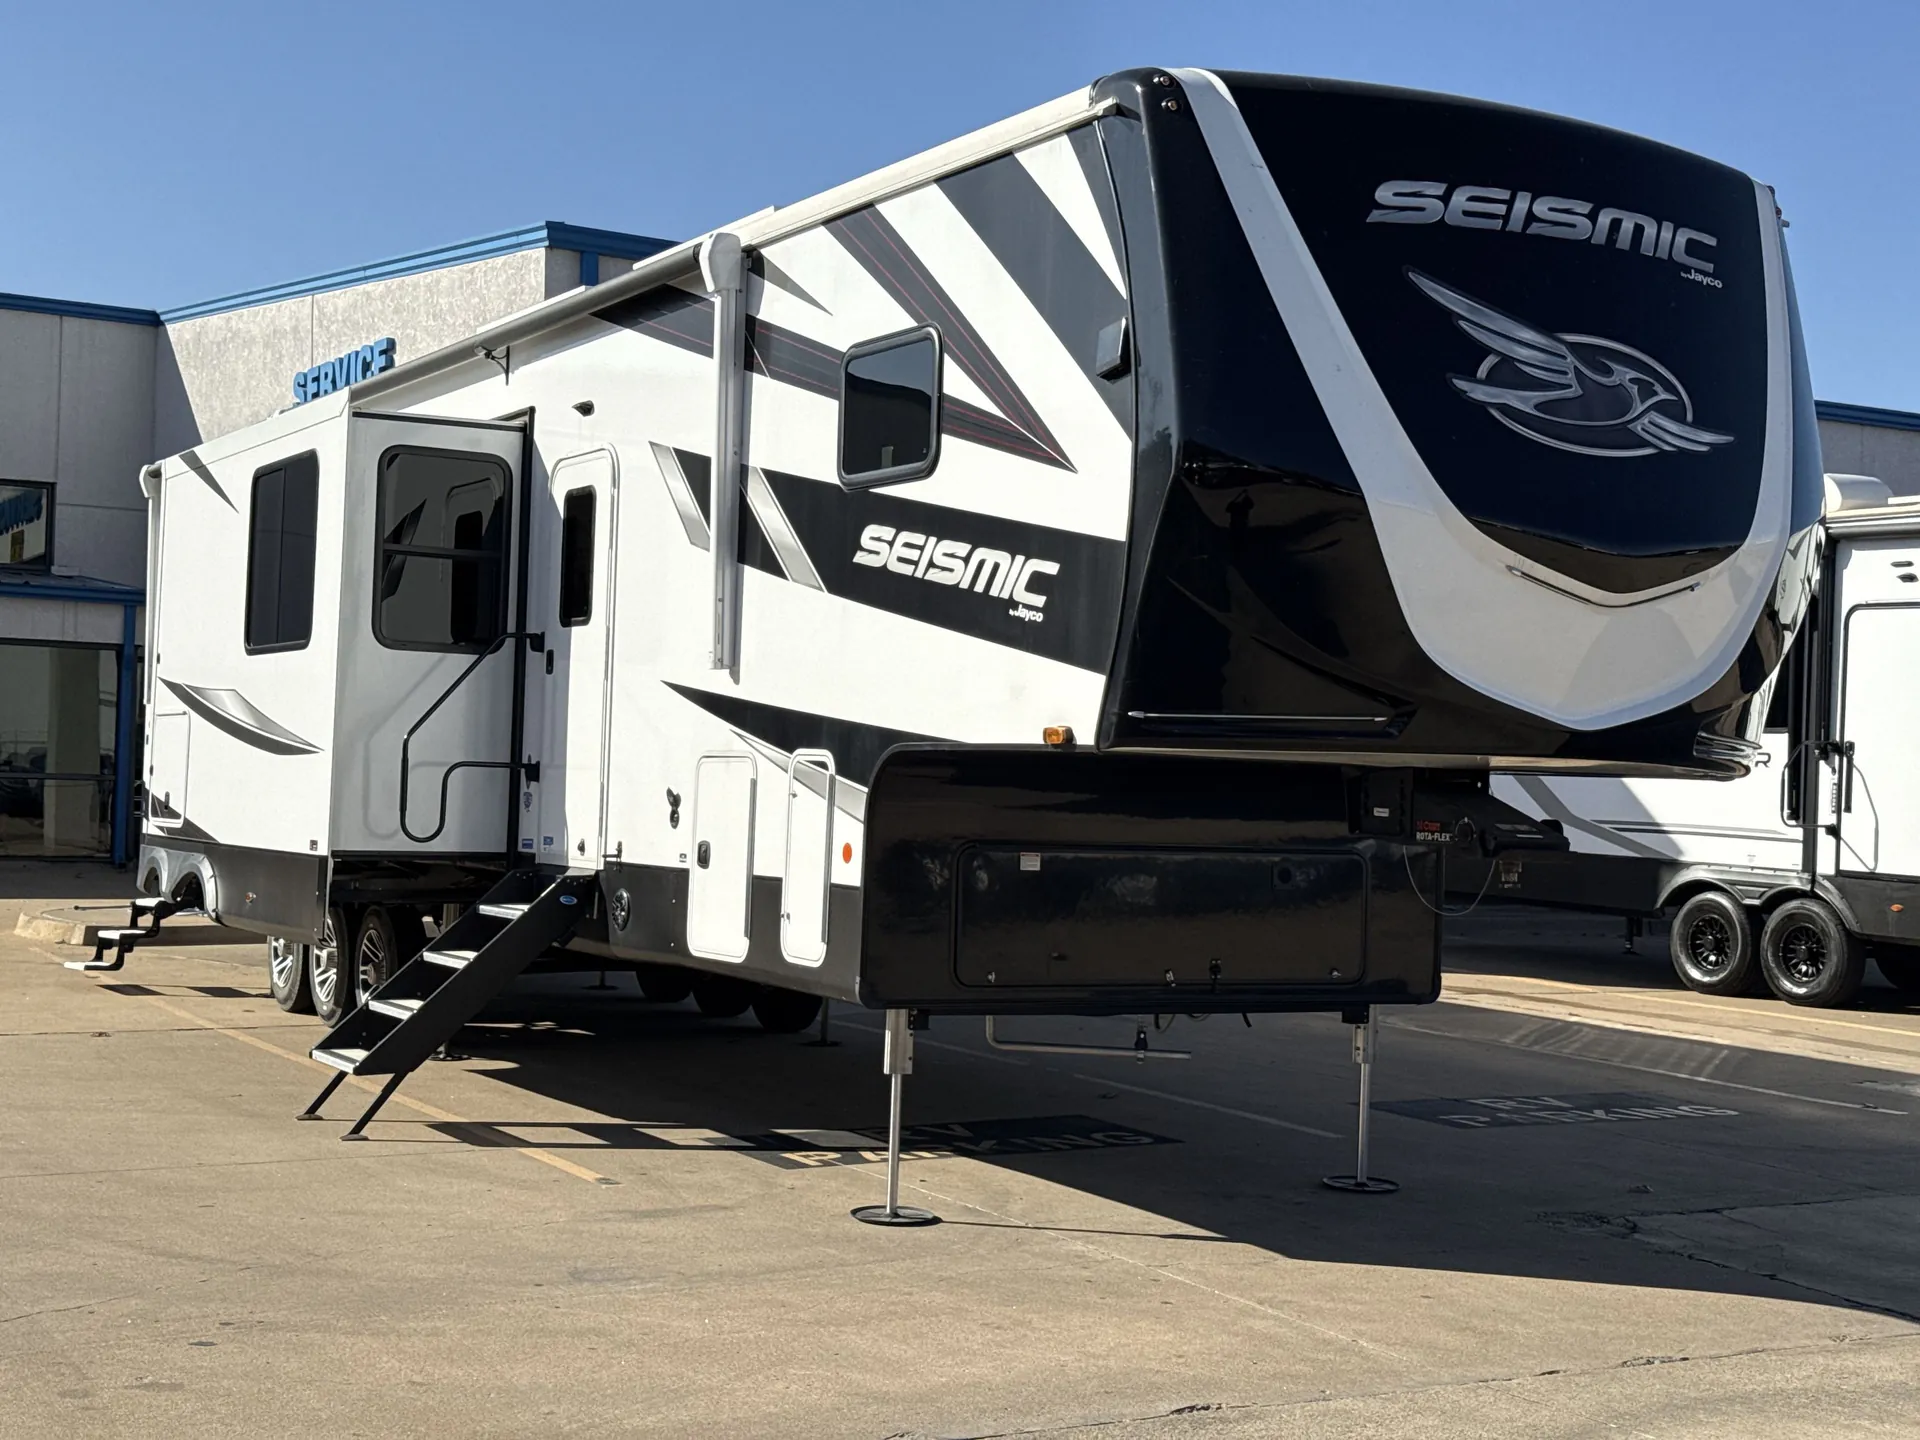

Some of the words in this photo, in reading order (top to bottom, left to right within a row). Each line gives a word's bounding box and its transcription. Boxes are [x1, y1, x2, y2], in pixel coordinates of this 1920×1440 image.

[1366, 179, 1718, 274] SEISMIC
[1687, 268, 1723, 289] Jayco
[293, 337, 397, 404] SERVICE
[852, 523, 1061, 608] SEISMIC
[1014, 603, 1044, 623] Jayco
[1464, 1096, 1570, 1109] RV
[1438, 1105, 1739, 1127] PARKING
